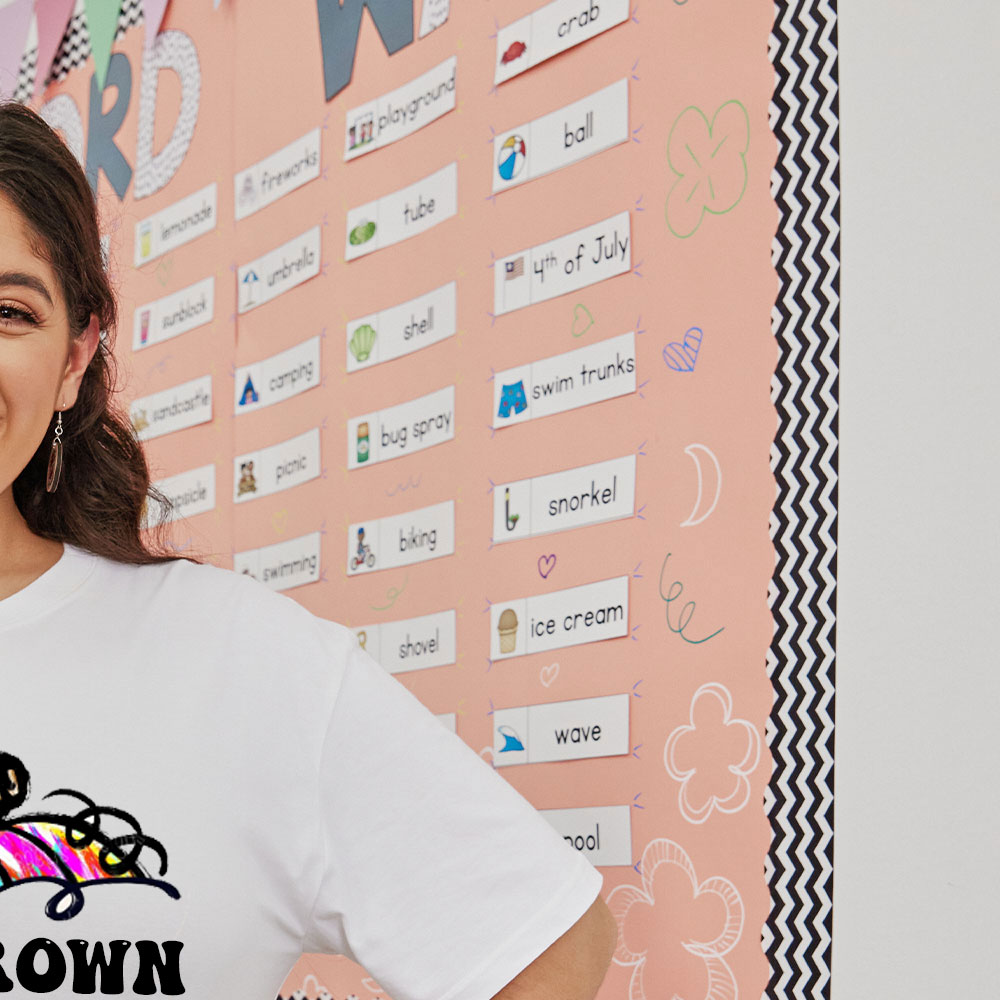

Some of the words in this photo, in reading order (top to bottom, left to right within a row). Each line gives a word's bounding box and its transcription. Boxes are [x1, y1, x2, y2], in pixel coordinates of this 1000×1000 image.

[557, 2, 600, 38] crab
[378, 66, 457, 136] playground
[564, 110, 594, 149] ball
[262, 149, 317, 193] fireworks
[161, 200, 211, 240] lemonade
[403, 197, 436, 224] tube
[268, 246, 314, 287] umbrella
[533, 252, 558, 283] 4th
[564, 244, 586, 276] of
[591, 230, 630, 265] July
[162, 293, 206, 329] sunblock
[403, 306, 434, 341] shell
[269, 361, 313, 392] camping
[532, 377, 575, 399] swim
[580, 352, 635, 388] trunks
[153, 387, 209, 422] sandcastle
[381, 425, 408, 450] bug
[413, 412, 452, 440] spray
[276, 456, 307, 484] picnic
[548, 475, 617, 517] snorkel
[399, 526, 437, 552] biking
[262, 554, 317, 583] swimming
[531, 616, 556, 638] ice
[563, 602, 623, 631] cream
[399, 628, 440, 658] shovel
[554, 722, 602, 746] wave
